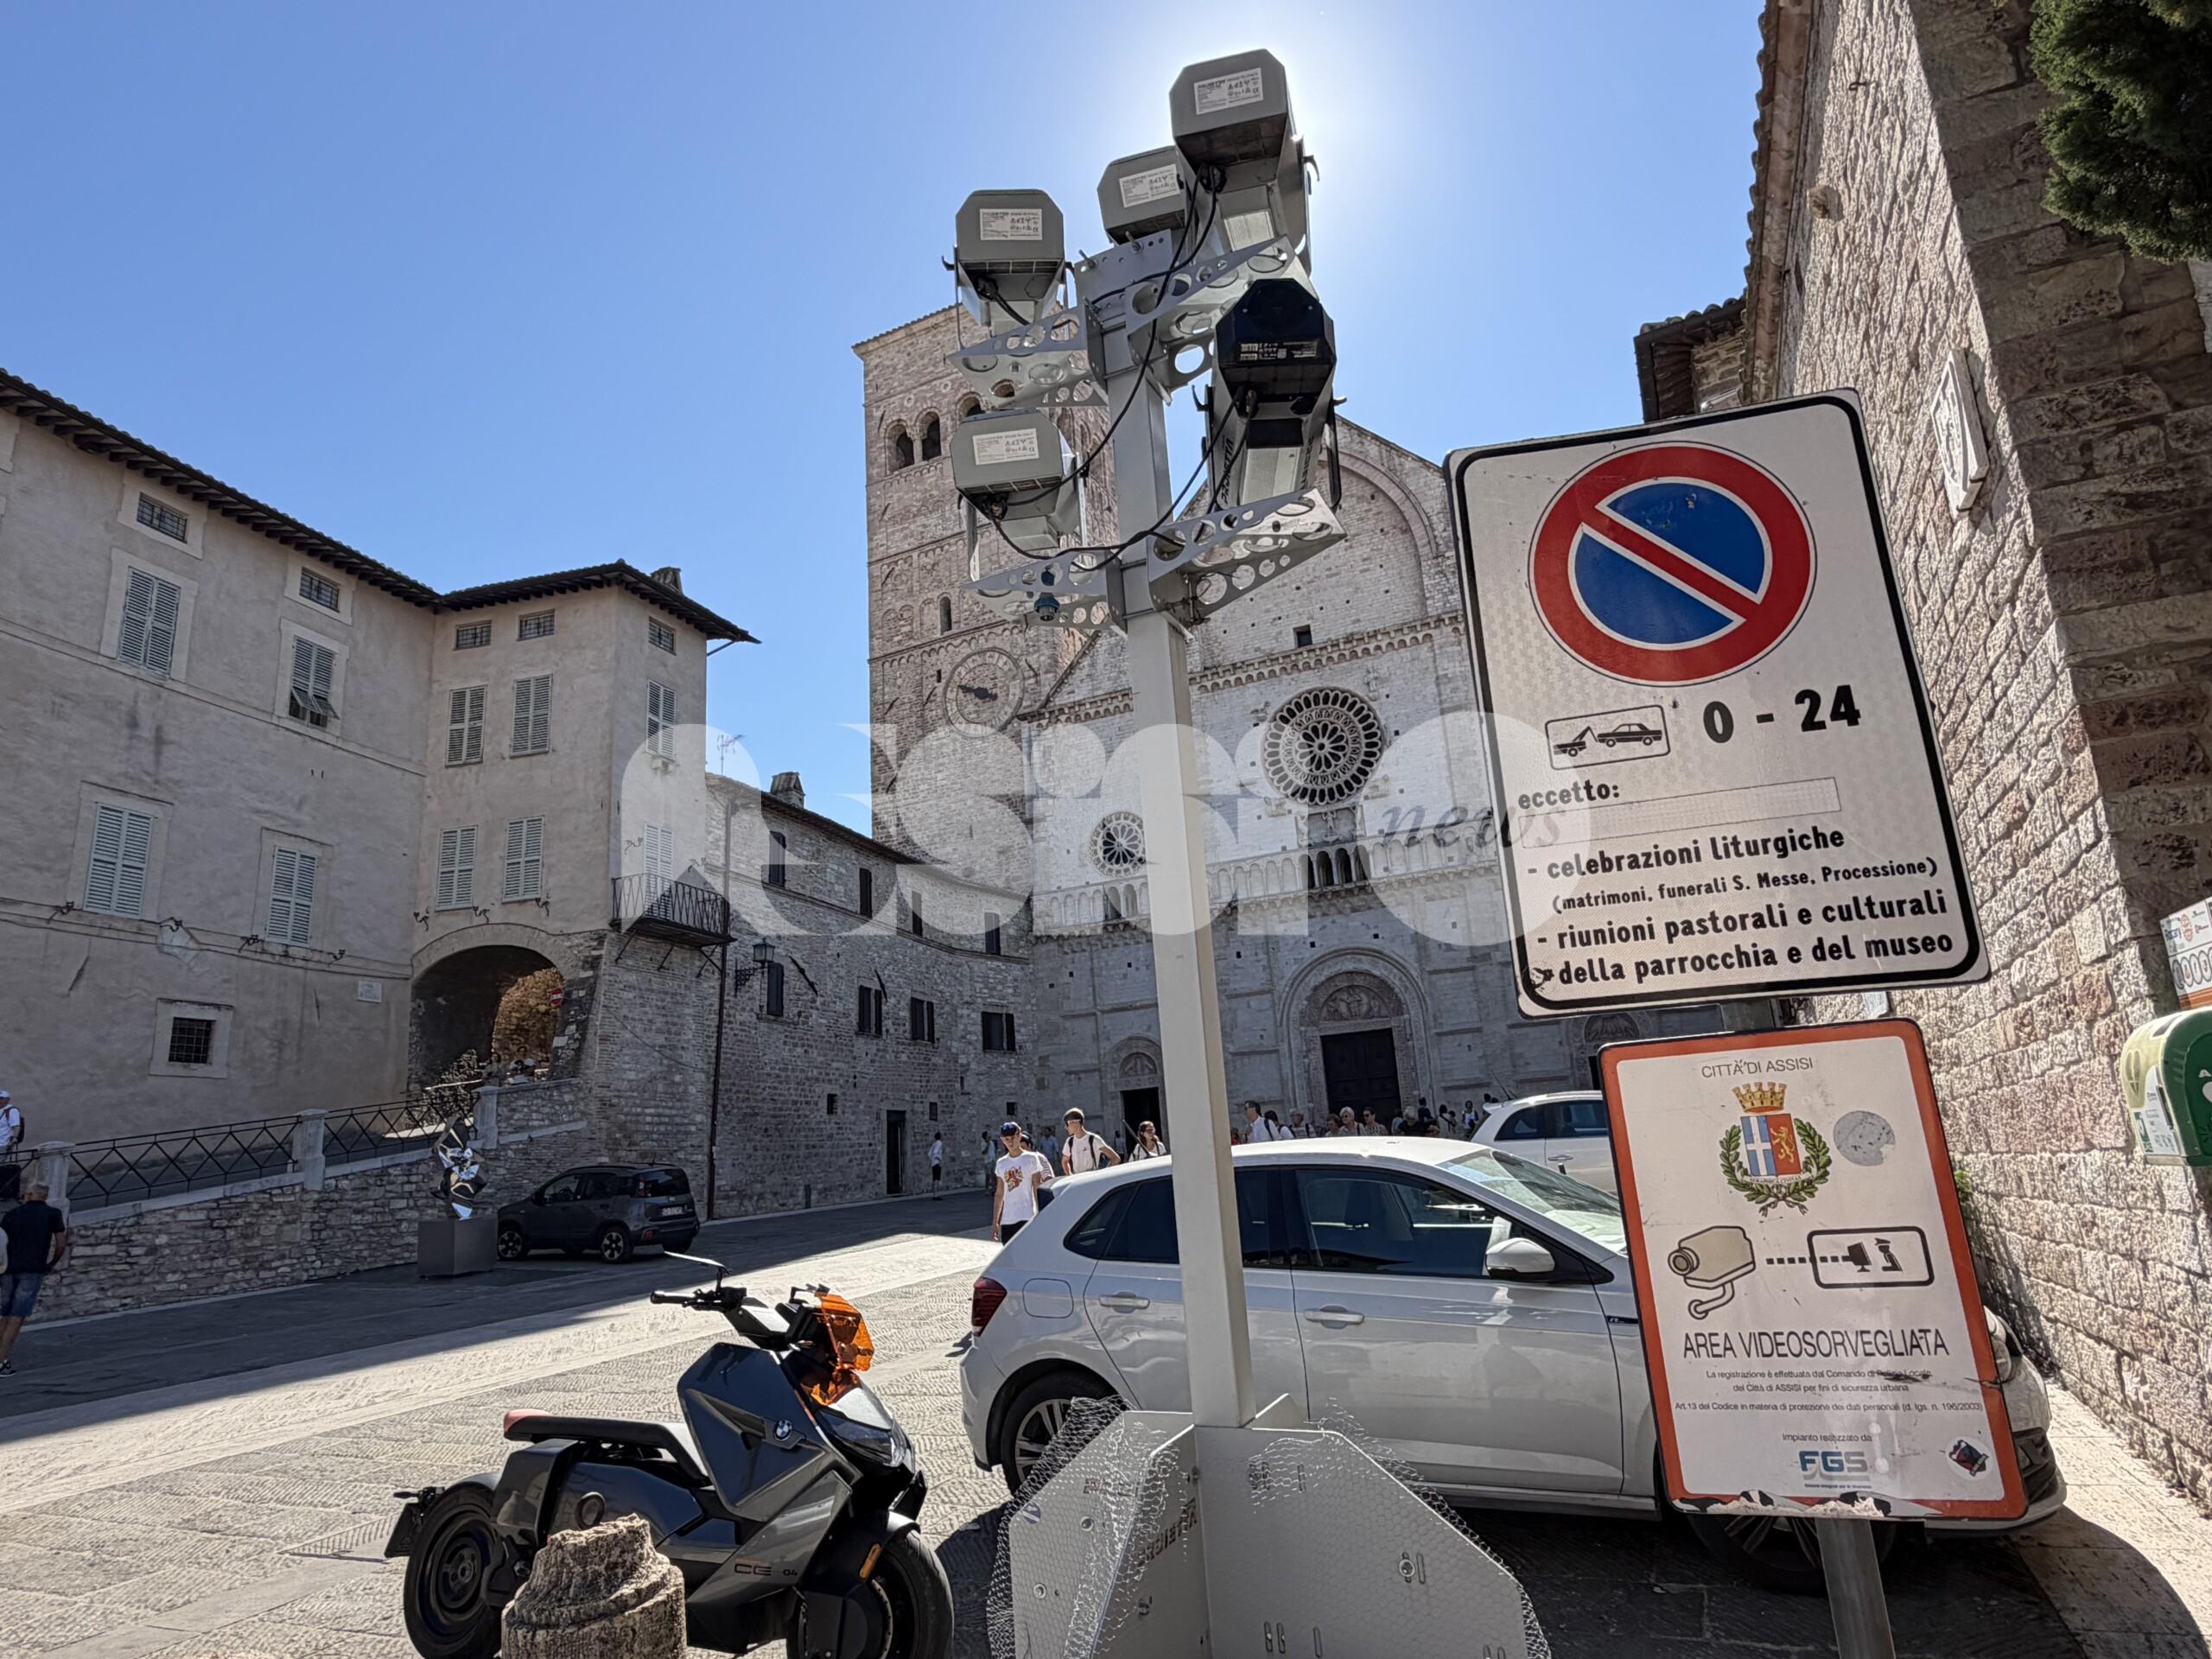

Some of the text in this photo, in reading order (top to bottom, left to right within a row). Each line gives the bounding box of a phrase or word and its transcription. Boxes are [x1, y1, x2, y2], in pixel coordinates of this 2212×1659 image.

[1703, 684, 1861, 744] 0 - 24
[1518, 779, 1620, 810] eccetto:
[1547, 839, 1702, 880] celebrazioni
[1709, 825, 1845, 861] liturgiche
[1552, 856, 1938, 914] (matrimoni, funerali S. Messe, Processione)
[1557, 916, 1656, 950] riunioni
[1664, 903, 1789, 944] pastorali
[1797, 907, 1813, 925] e
[1821, 888, 1948, 923] culturali
[1559, 933, 1954, 985] della parrocchia e del museo
[1765, 1057, 1814, 1073] ASSISI
[1683, 1328, 1950, 1359] AREA VIDEOSORVEGLIATA
[1706, 1370, 1717, 1379] La
[1717, 1370, 1766, 1381] registrazione
[1774, 1369, 1811, 1379] effettuata
[1825, 1369, 1866, 1378] Comando
[1765, 1383, 1772, 1392] di
[1775, 1383, 1802, 1392] ASSISI
[1803, 1384, 1816, 1395] per
[1831, 1383, 1840, 1392] di
[1841, 1383, 1879, 1392] sicurezza
[1880, 1383, 1909, 1392] urbana
[1712, 1402, 1739, 1411] Codice
[1789, 1402, 1831, 1412] protezione
[1863, 1402, 1900, 1413] personali
[1783, 1433, 1818, 1443] Impianto
[1798, 1451, 1868, 1472] FGS
[734, 1563, 772, 1577] CE
